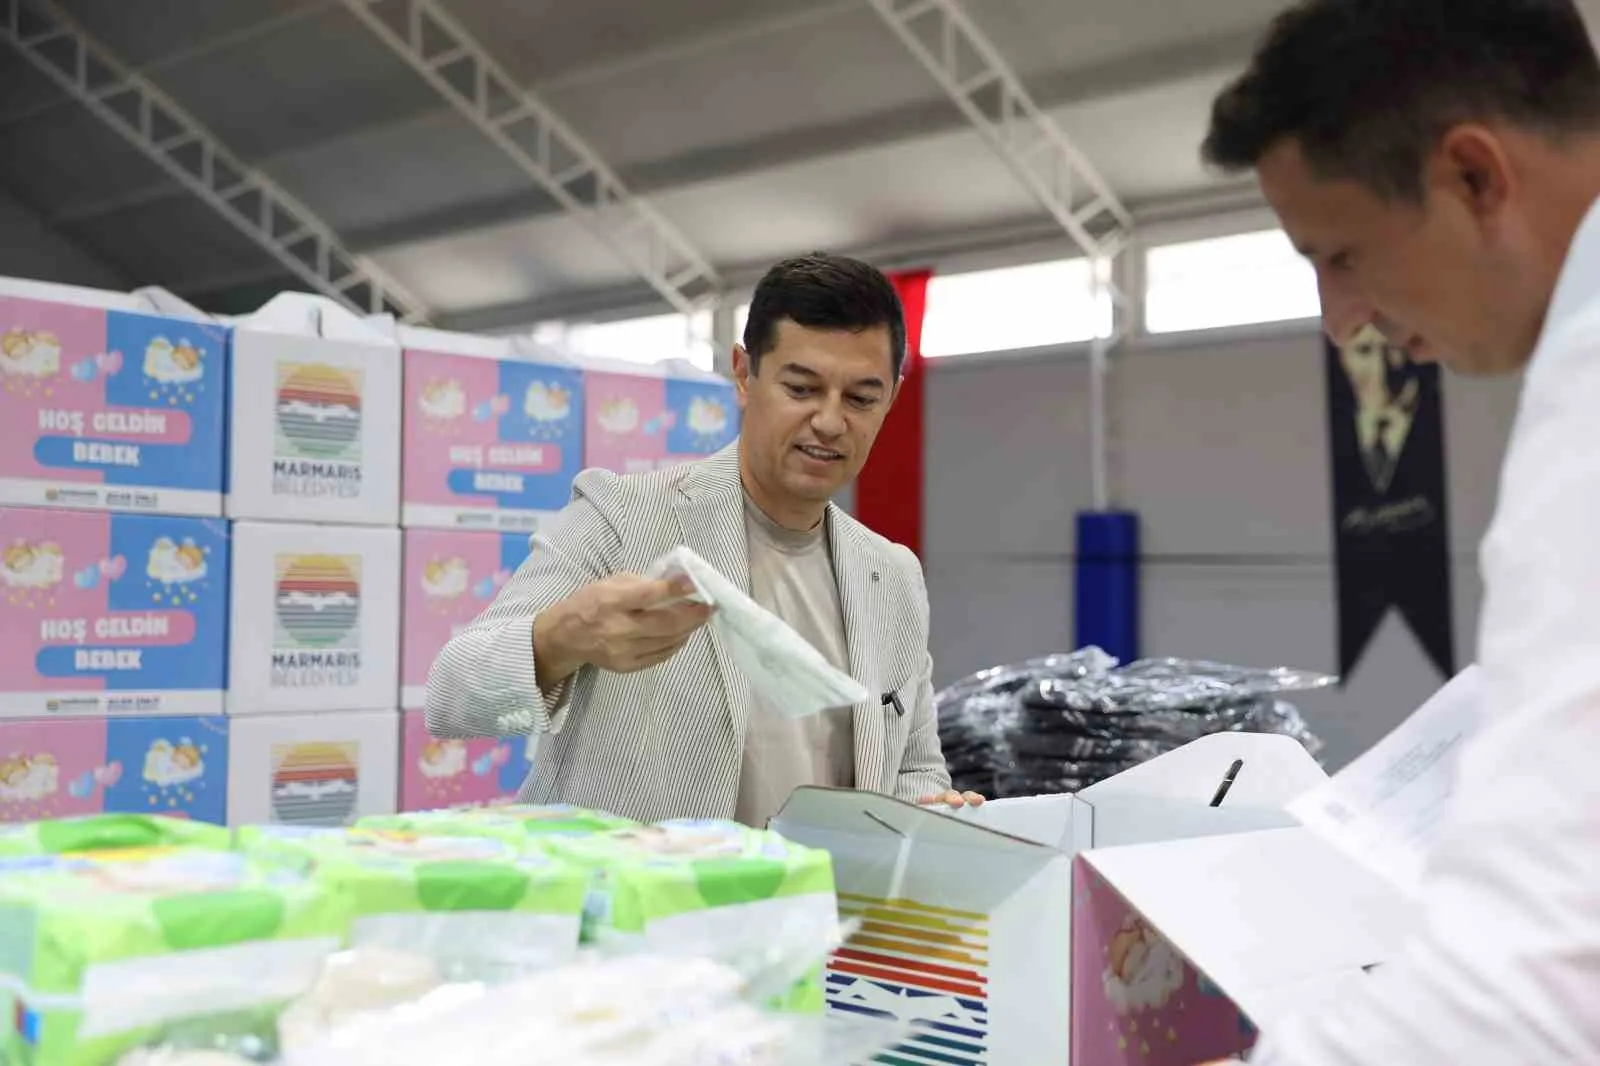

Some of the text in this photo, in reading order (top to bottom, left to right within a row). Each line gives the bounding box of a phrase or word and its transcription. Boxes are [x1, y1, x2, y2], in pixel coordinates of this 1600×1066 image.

[38, 409, 85, 437] HOŞ
[73, 441, 140, 466] BEBEK
[40, 617, 87, 644] HOŞ
[74, 647, 142, 670] BEBEK
